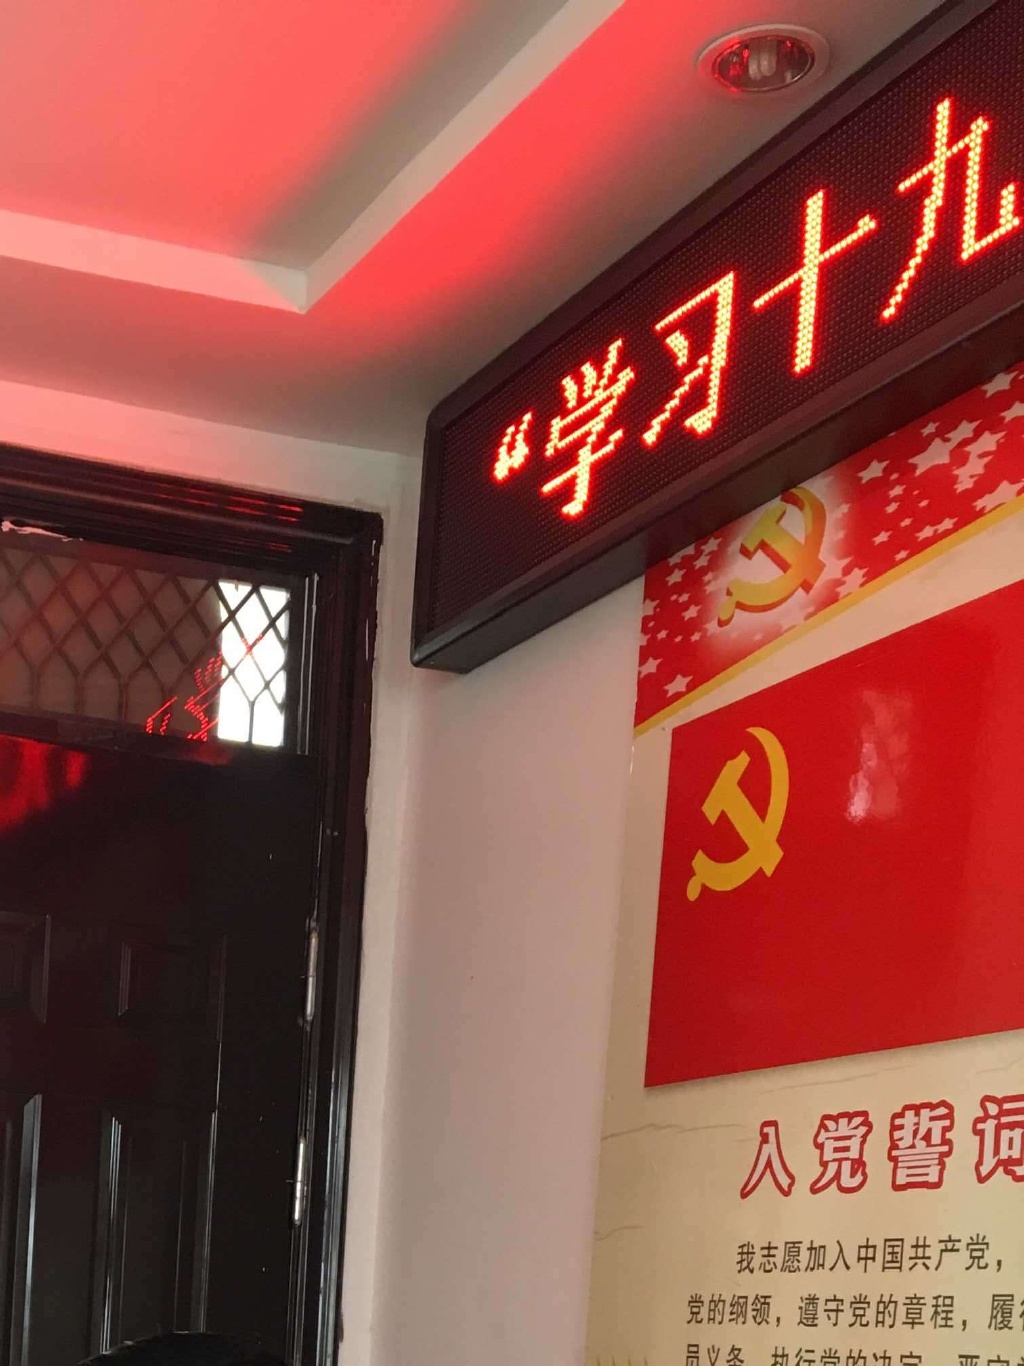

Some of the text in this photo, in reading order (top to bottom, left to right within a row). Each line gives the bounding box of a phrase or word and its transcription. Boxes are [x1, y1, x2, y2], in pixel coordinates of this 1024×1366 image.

[740, 1094, 1024, 1199] 入党誓词
[736, 1233, 1002, 1274] 我志愿加入中国共产党，
[686, 1292, 1024, 1332] 党的纲领，遵守党的章程，履
